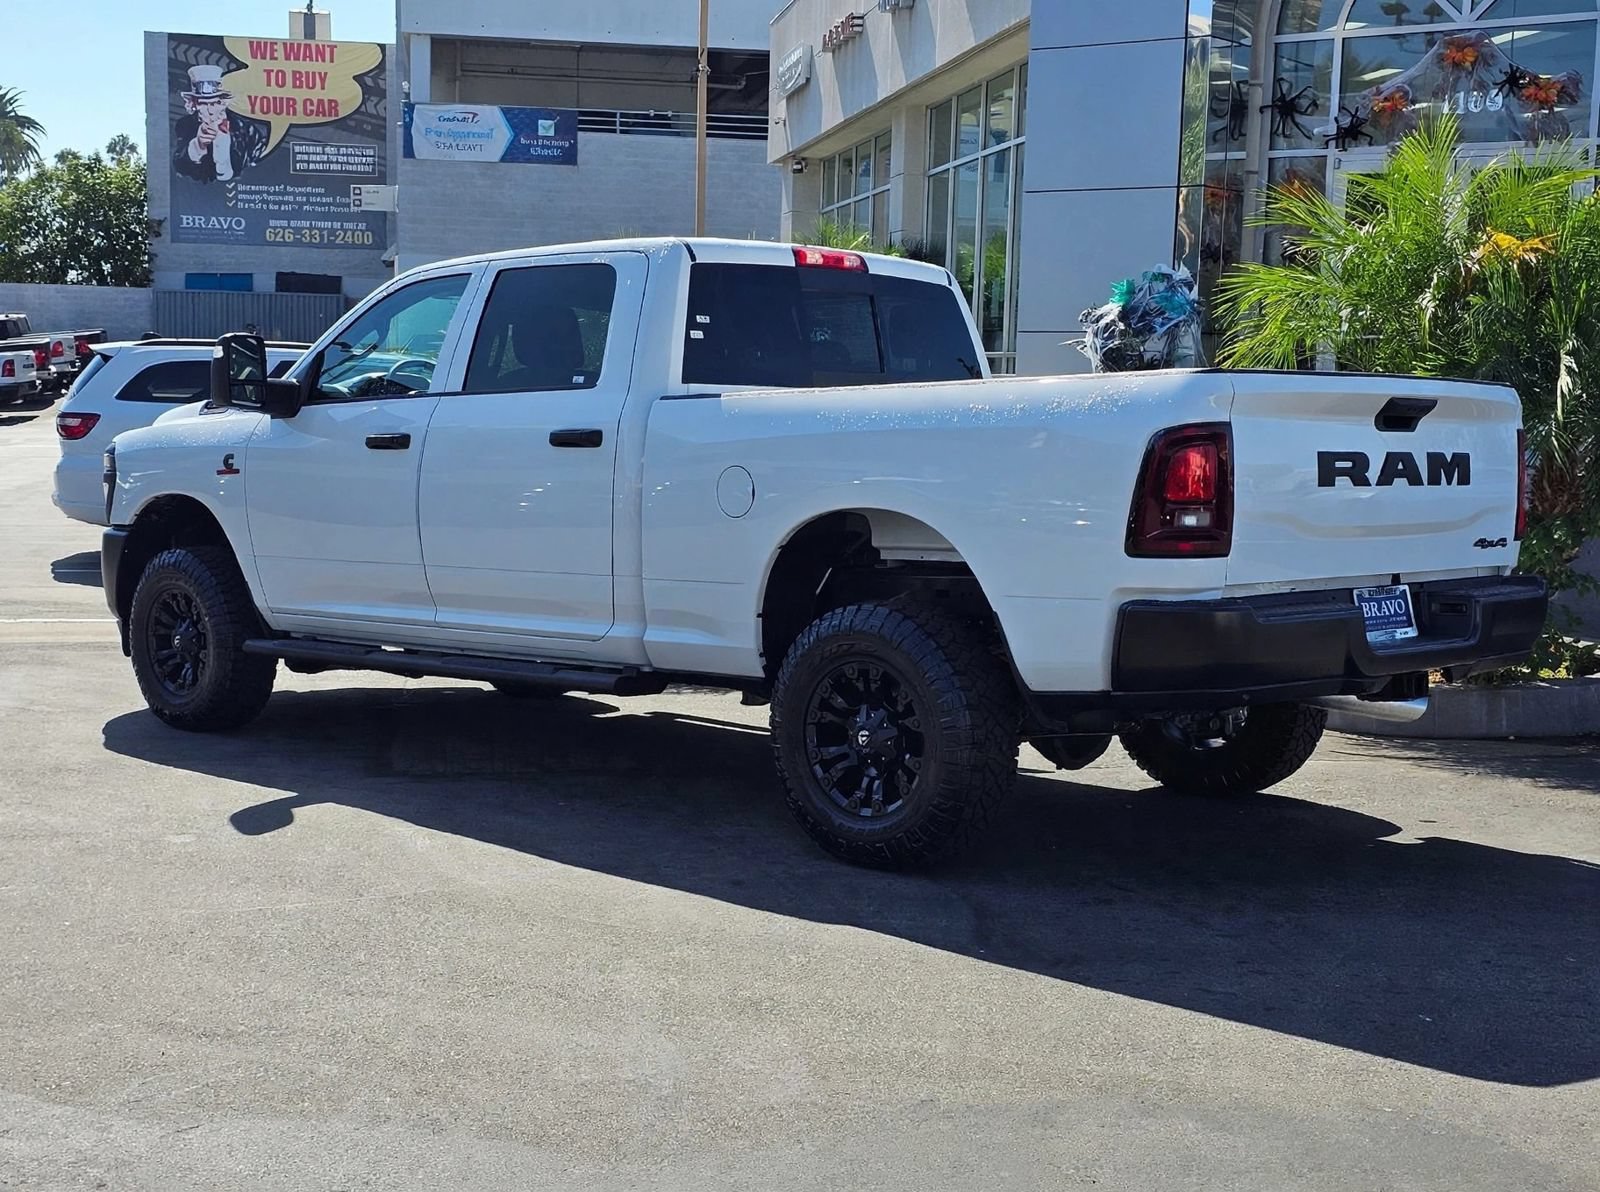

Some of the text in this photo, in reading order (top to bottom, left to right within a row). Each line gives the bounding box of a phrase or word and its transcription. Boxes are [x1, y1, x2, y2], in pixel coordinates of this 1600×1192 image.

[249, 40, 337, 63] WE WANT
[263, 69, 328, 91] TO BUY
[248, 95, 339, 117] YOUR CAR
[180, 214, 246, 230] BRAVO
[265, 228, 373, 245] 626-331-2400
[1317, 451, 1471, 487] RAM
[1361, 599, 1406, 618] BRAVO
